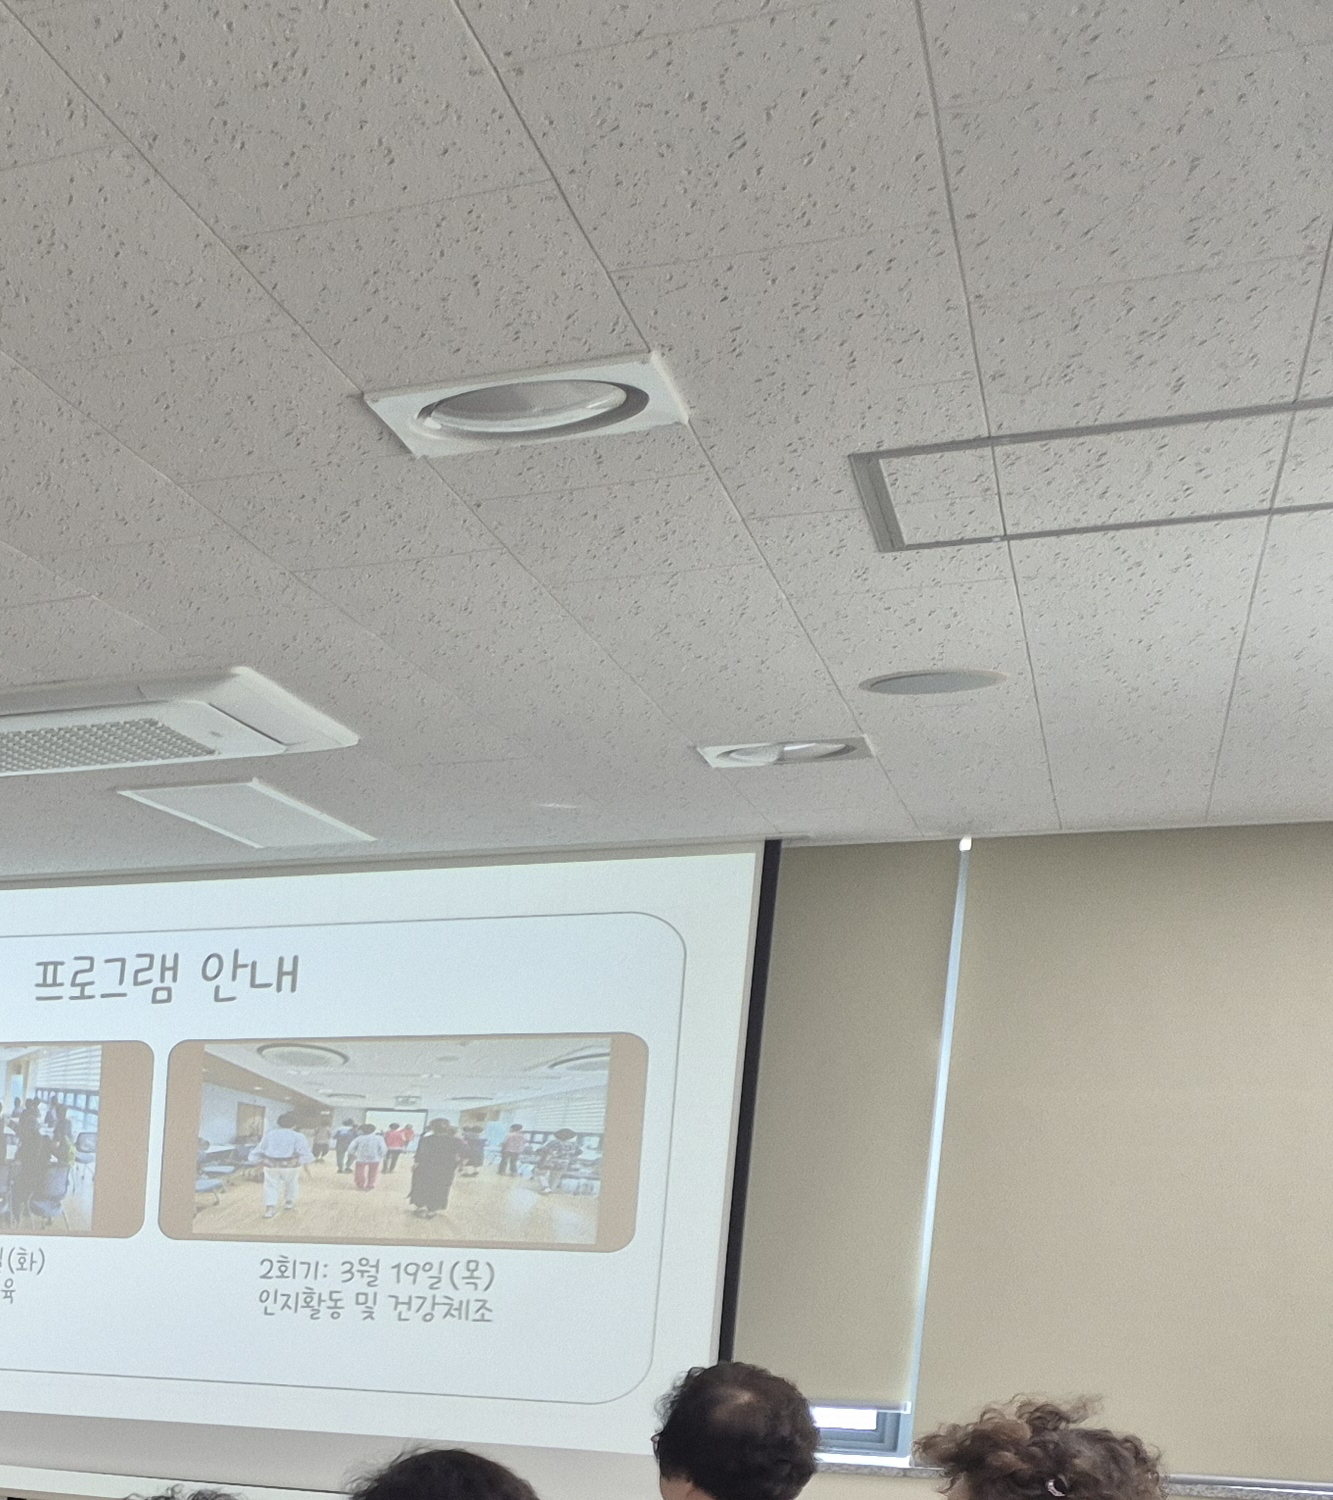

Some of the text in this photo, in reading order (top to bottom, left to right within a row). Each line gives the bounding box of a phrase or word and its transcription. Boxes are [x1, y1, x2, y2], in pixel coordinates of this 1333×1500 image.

[35, 948, 299, 1005] 프로그램 안내
[259, 1255, 495, 1292] 2회기: 3월 19일(목)
[259, 1286, 494, 1323] 인지활동 및 건강체조
